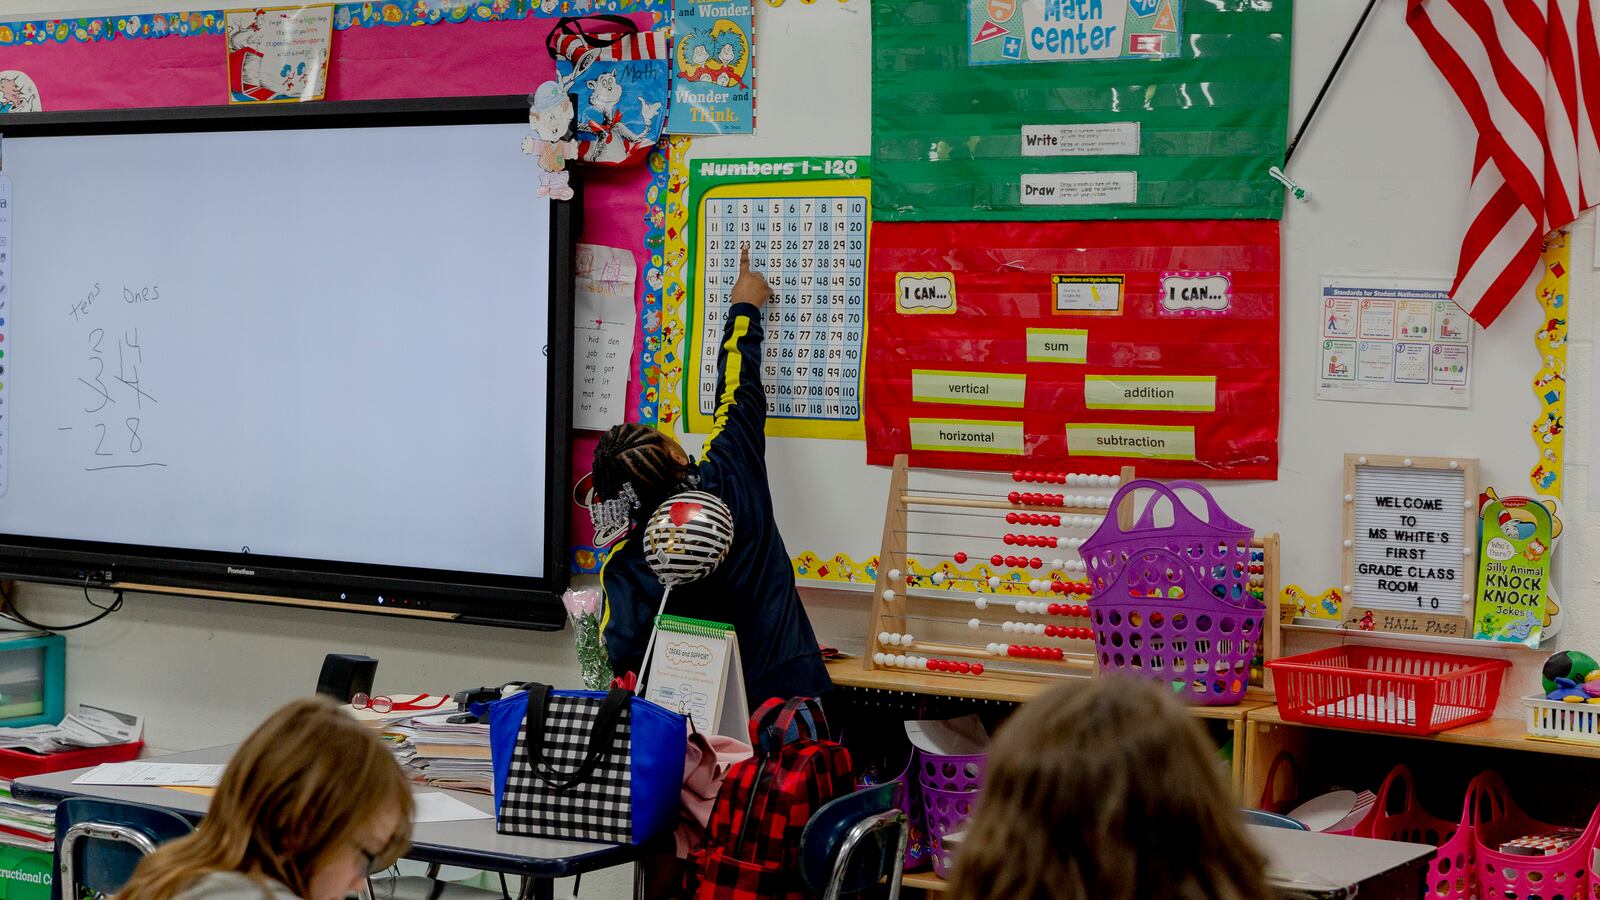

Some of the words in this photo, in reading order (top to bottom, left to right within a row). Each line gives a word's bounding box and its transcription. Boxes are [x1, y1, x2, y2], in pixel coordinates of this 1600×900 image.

[678, 7, 696, 17] and
[698, 3, 750, 18] Wonder.
[1044, 0, 1103, 21] Math
[1031, 23, 1117, 55] center
[620, 61, 657, 83] Math
[675, 90, 729, 104] Wonder
[732, 92, 749, 101] and
[690, 106, 740, 122] Think.
[1026, 134, 1058, 146] Write
[700, 161, 794, 176] Numbers
[1025, 184, 1055, 196] Draw
[713, 205, 716, 214] 1
[728, 204, 732, 214] 2
[743, 204, 748, 214] 3
[758, 205, 764, 213] 4
[774, 204, 779, 214] 5
[789, 204, 795, 213] 6
[805, 204, 811, 213] 7
[821, 204, 827, 213] 8
[837, 203, 842, 213] 9
[852, 203, 861, 213] 10
[711, 223, 718, 232] 11
[726, 222, 734, 232] 12
[741, 222, 750, 232] 13
[757, 223, 765, 231] 14
[773, 222, 781, 232] 15
[788, 222, 797, 232] 16
[804, 222, 812, 231] 17
[820, 222, 828, 232] 18
[835, 222, 844, 231] 19
[850, 222, 862, 231] 20
[710, 240, 718, 250] 21
[724, 240, 735, 249] 22
[739, 240, 750, 250] 23
[755, 240, 766, 250] 24
[771, 240, 782, 250] 25
[786, 240, 798, 250] 26
[802, 240, 813, 250] 27
[818, 240, 829, 250] 28
[833, 240, 845, 250] 29
[850, 240, 862, 250] 30
[709, 258, 718, 267] 31
[724, 258, 735, 267] 32
[754, 258, 766, 268] 34
[770, 258, 781, 268] 35
[786, 258, 797, 268] 36
[802, 258, 813, 268] 37
[817, 258, 829, 268] 38
[833, 258, 845, 268] 39
[849, 258, 861, 268] 40
[708, 276, 718, 285] 41
[723, 276, 734, 285] 42
[769, 276, 781, 285] 45
[785, 277, 797, 286] 46
[801, 277, 812, 286] 47
[817, 277, 828, 286] 48
[832, 277, 844, 286] 49
[849, 277, 861, 286] 50
[904, 286, 910, 300] I
[914, 286, 947, 300] CAN...
[1170, 286, 1175, 300] I
[1181, 285, 1222, 301] CAN...
[69, 282, 101, 321] tens
[89, 328, 104, 353] 2
[588, 335, 599, 344] hid
[708, 329, 716, 338] 71
[768, 330, 779, 340] 75
[784, 330, 795, 340] 76
[800, 331, 811, 340] 77
[815, 331, 826, 341] 78
[831, 331, 842, 341] 79
[847, 332, 859, 341] 80
[586, 349, 598, 358] job
[1044, 342, 1069, 352] sum
[705, 365, 713, 374] 91
[765, 366, 776, 376] 95
[780, 367, 792, 376] 96
[796, 367, 808, 376] 97
[812, 368, 823, 377] 98
[827, 368, 839, 377] 99
[842, 368, 857, 378] 100
[949, 383, 989, 395] vertical
[1124, 387, 1174, 399] addition
[939, 430, 995, 443] horizontal
[1096, 435, 1165, 448] subtraction
[1375, 496, 1443, 510] WELCOME
[1399, 515, 1416, 527] TO
[1369, 528, 1387, 540] MS
[1395, 530, 1449, 543] WHITE'S
[1491, 541, 1510, 551] Who's
[1386, 548, 1426, 560] FIRST
[1489, 549, 1511, 558] There?
[1358, 564, 1402, 577] GRADE
[1408, 567, 1455, 580] CLASS
[1487, 562, 1507, 575] Silly
[1510, 565, 1543, 576] Animal
[1378, 580, 1418, 592] ROOM
[1485, 574, 1541, 591] KNOCK
[1483, 589, 1539, 607] KNOCK
[1496, 606, 1525, 617] Jokes
[1383, 616, 1419, 631] HALL
[1427, 620, 1457, 635] PASS
[690, 651, 710, 660] SUPPORT
